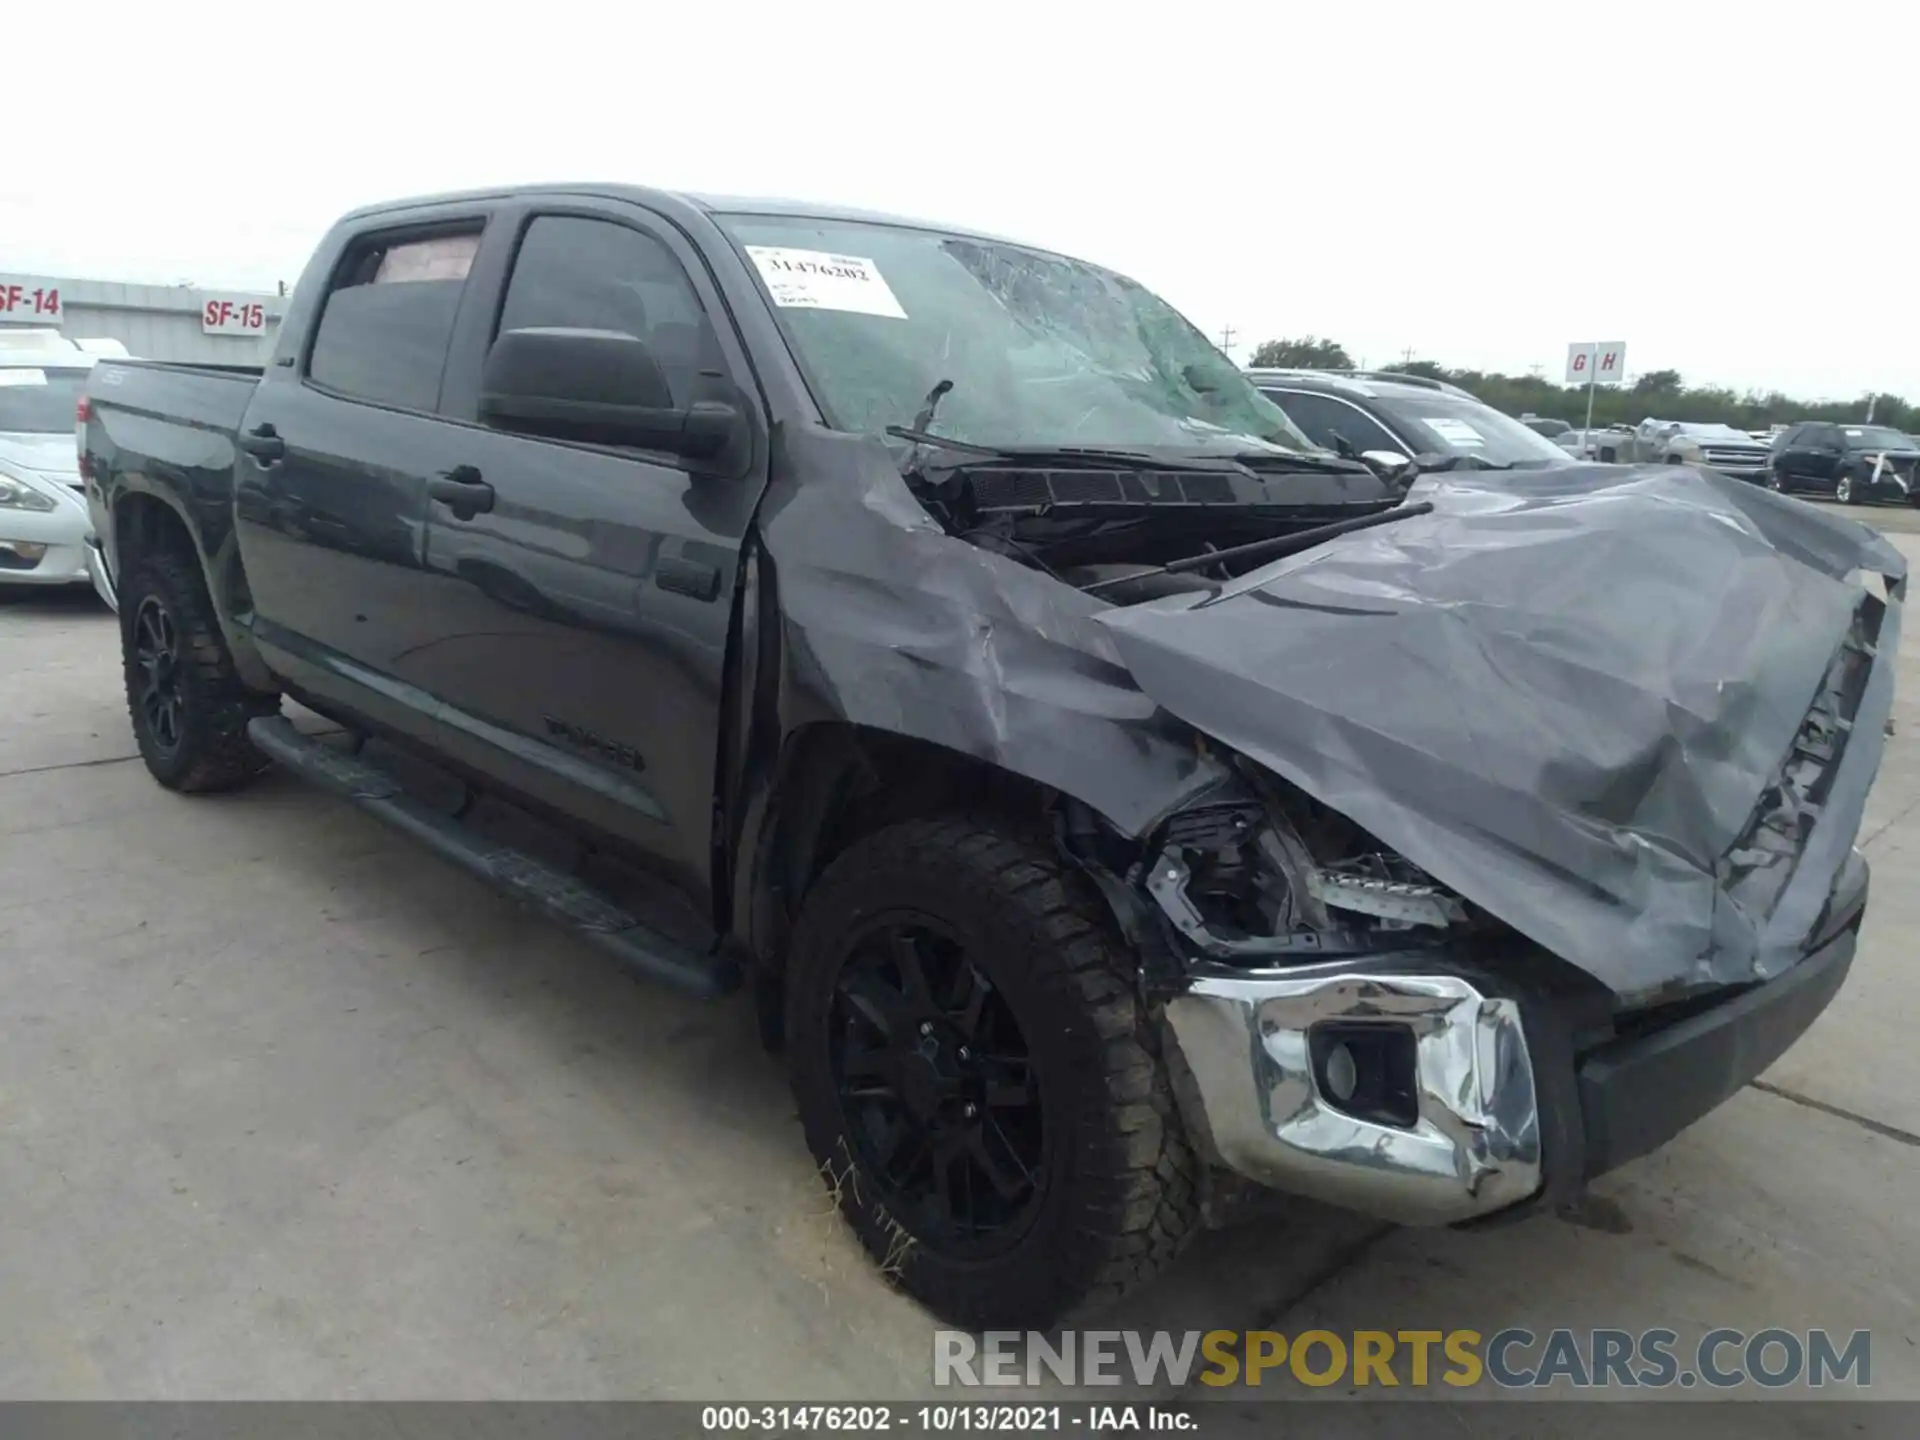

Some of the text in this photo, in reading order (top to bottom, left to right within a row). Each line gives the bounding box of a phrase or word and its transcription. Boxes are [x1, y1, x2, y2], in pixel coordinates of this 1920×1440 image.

[205, 300, 263, 328] SF-15
[1573, 354, 1587, 371] G
[1601, 352, 1617, 370] H
